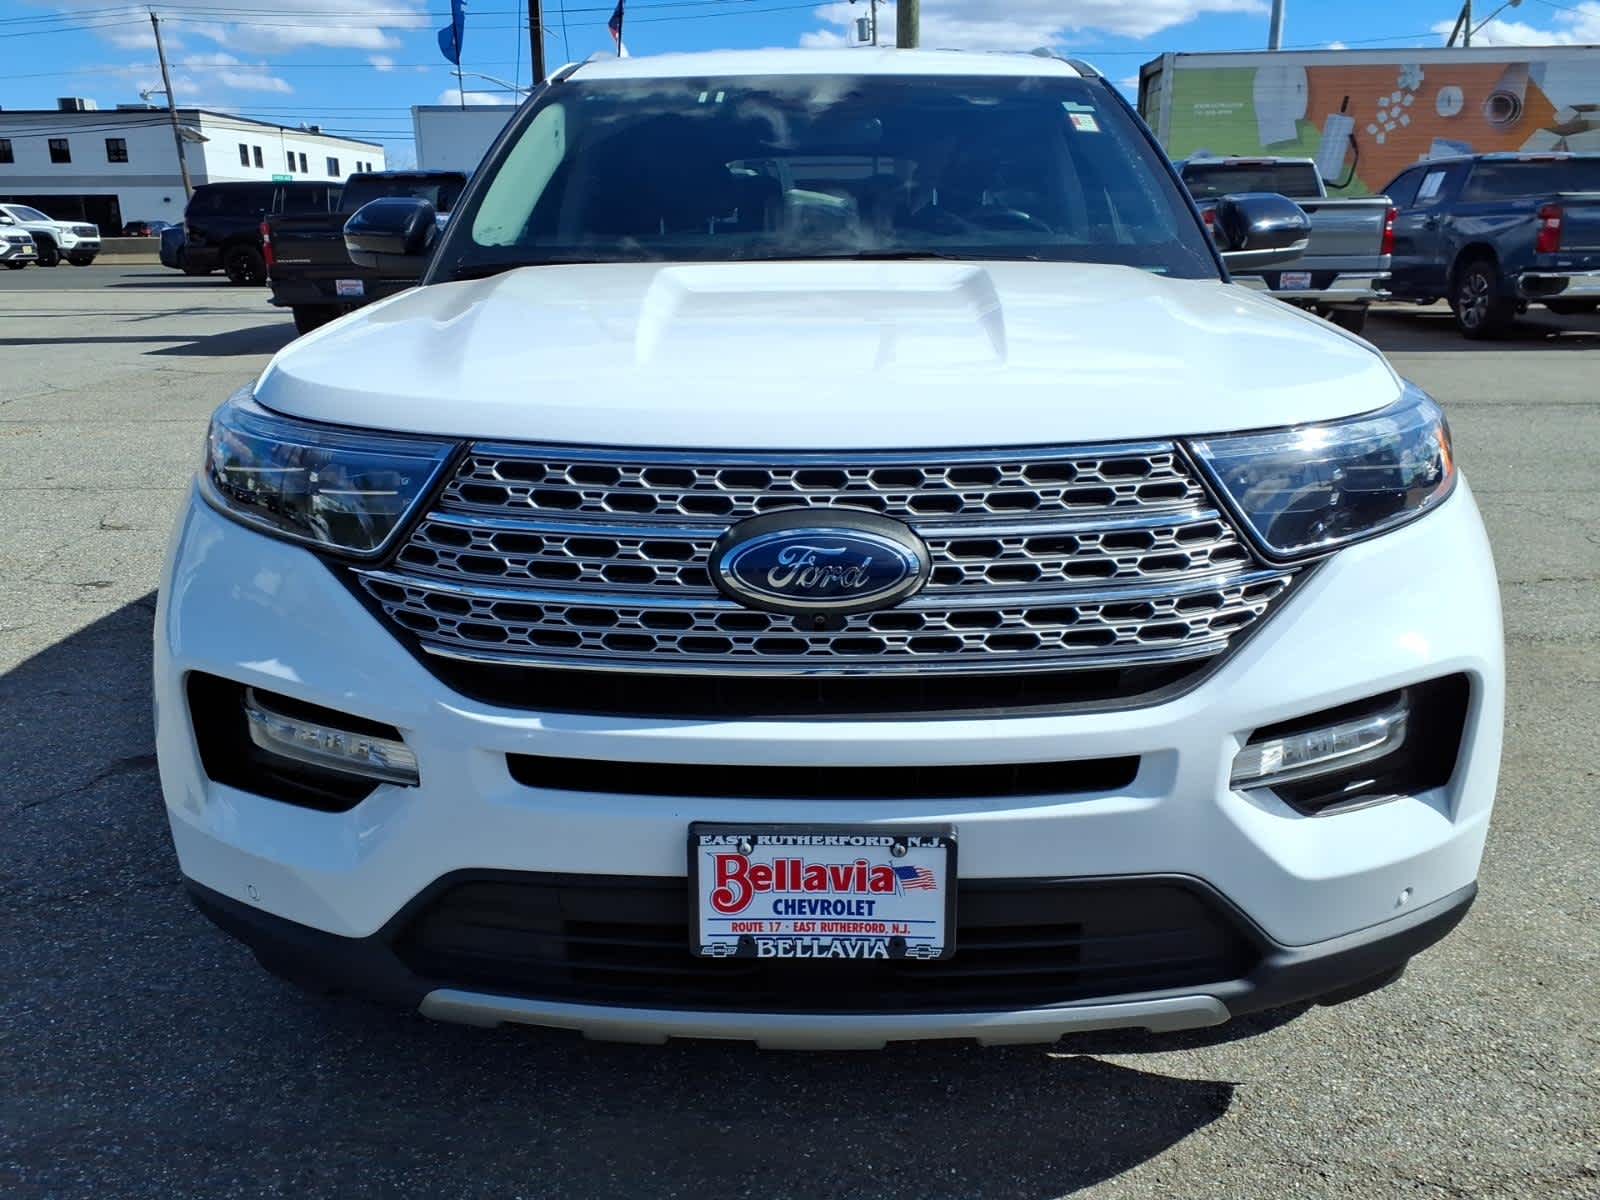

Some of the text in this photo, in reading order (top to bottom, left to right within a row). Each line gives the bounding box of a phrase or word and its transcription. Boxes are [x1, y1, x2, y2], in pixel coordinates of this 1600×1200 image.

[767, 545, 872, 588] Ford
[700, 835, 752, 846] EAST
[907, 837, 947, 848] N.J.
[711, 853, 896, 915] Bellavia
[772, 898, 876, 917] CHEVROLET
[731, 921, 764, 932] ROUTE
[769, 922, 781, 932] 17
[793, 922, 816, 933] EAST
[820, 922, 889, 935] RUTHERFORD,
[892, 924, 911, 934] N.J.
[757, 938, 890, 959] BELLAVIA
